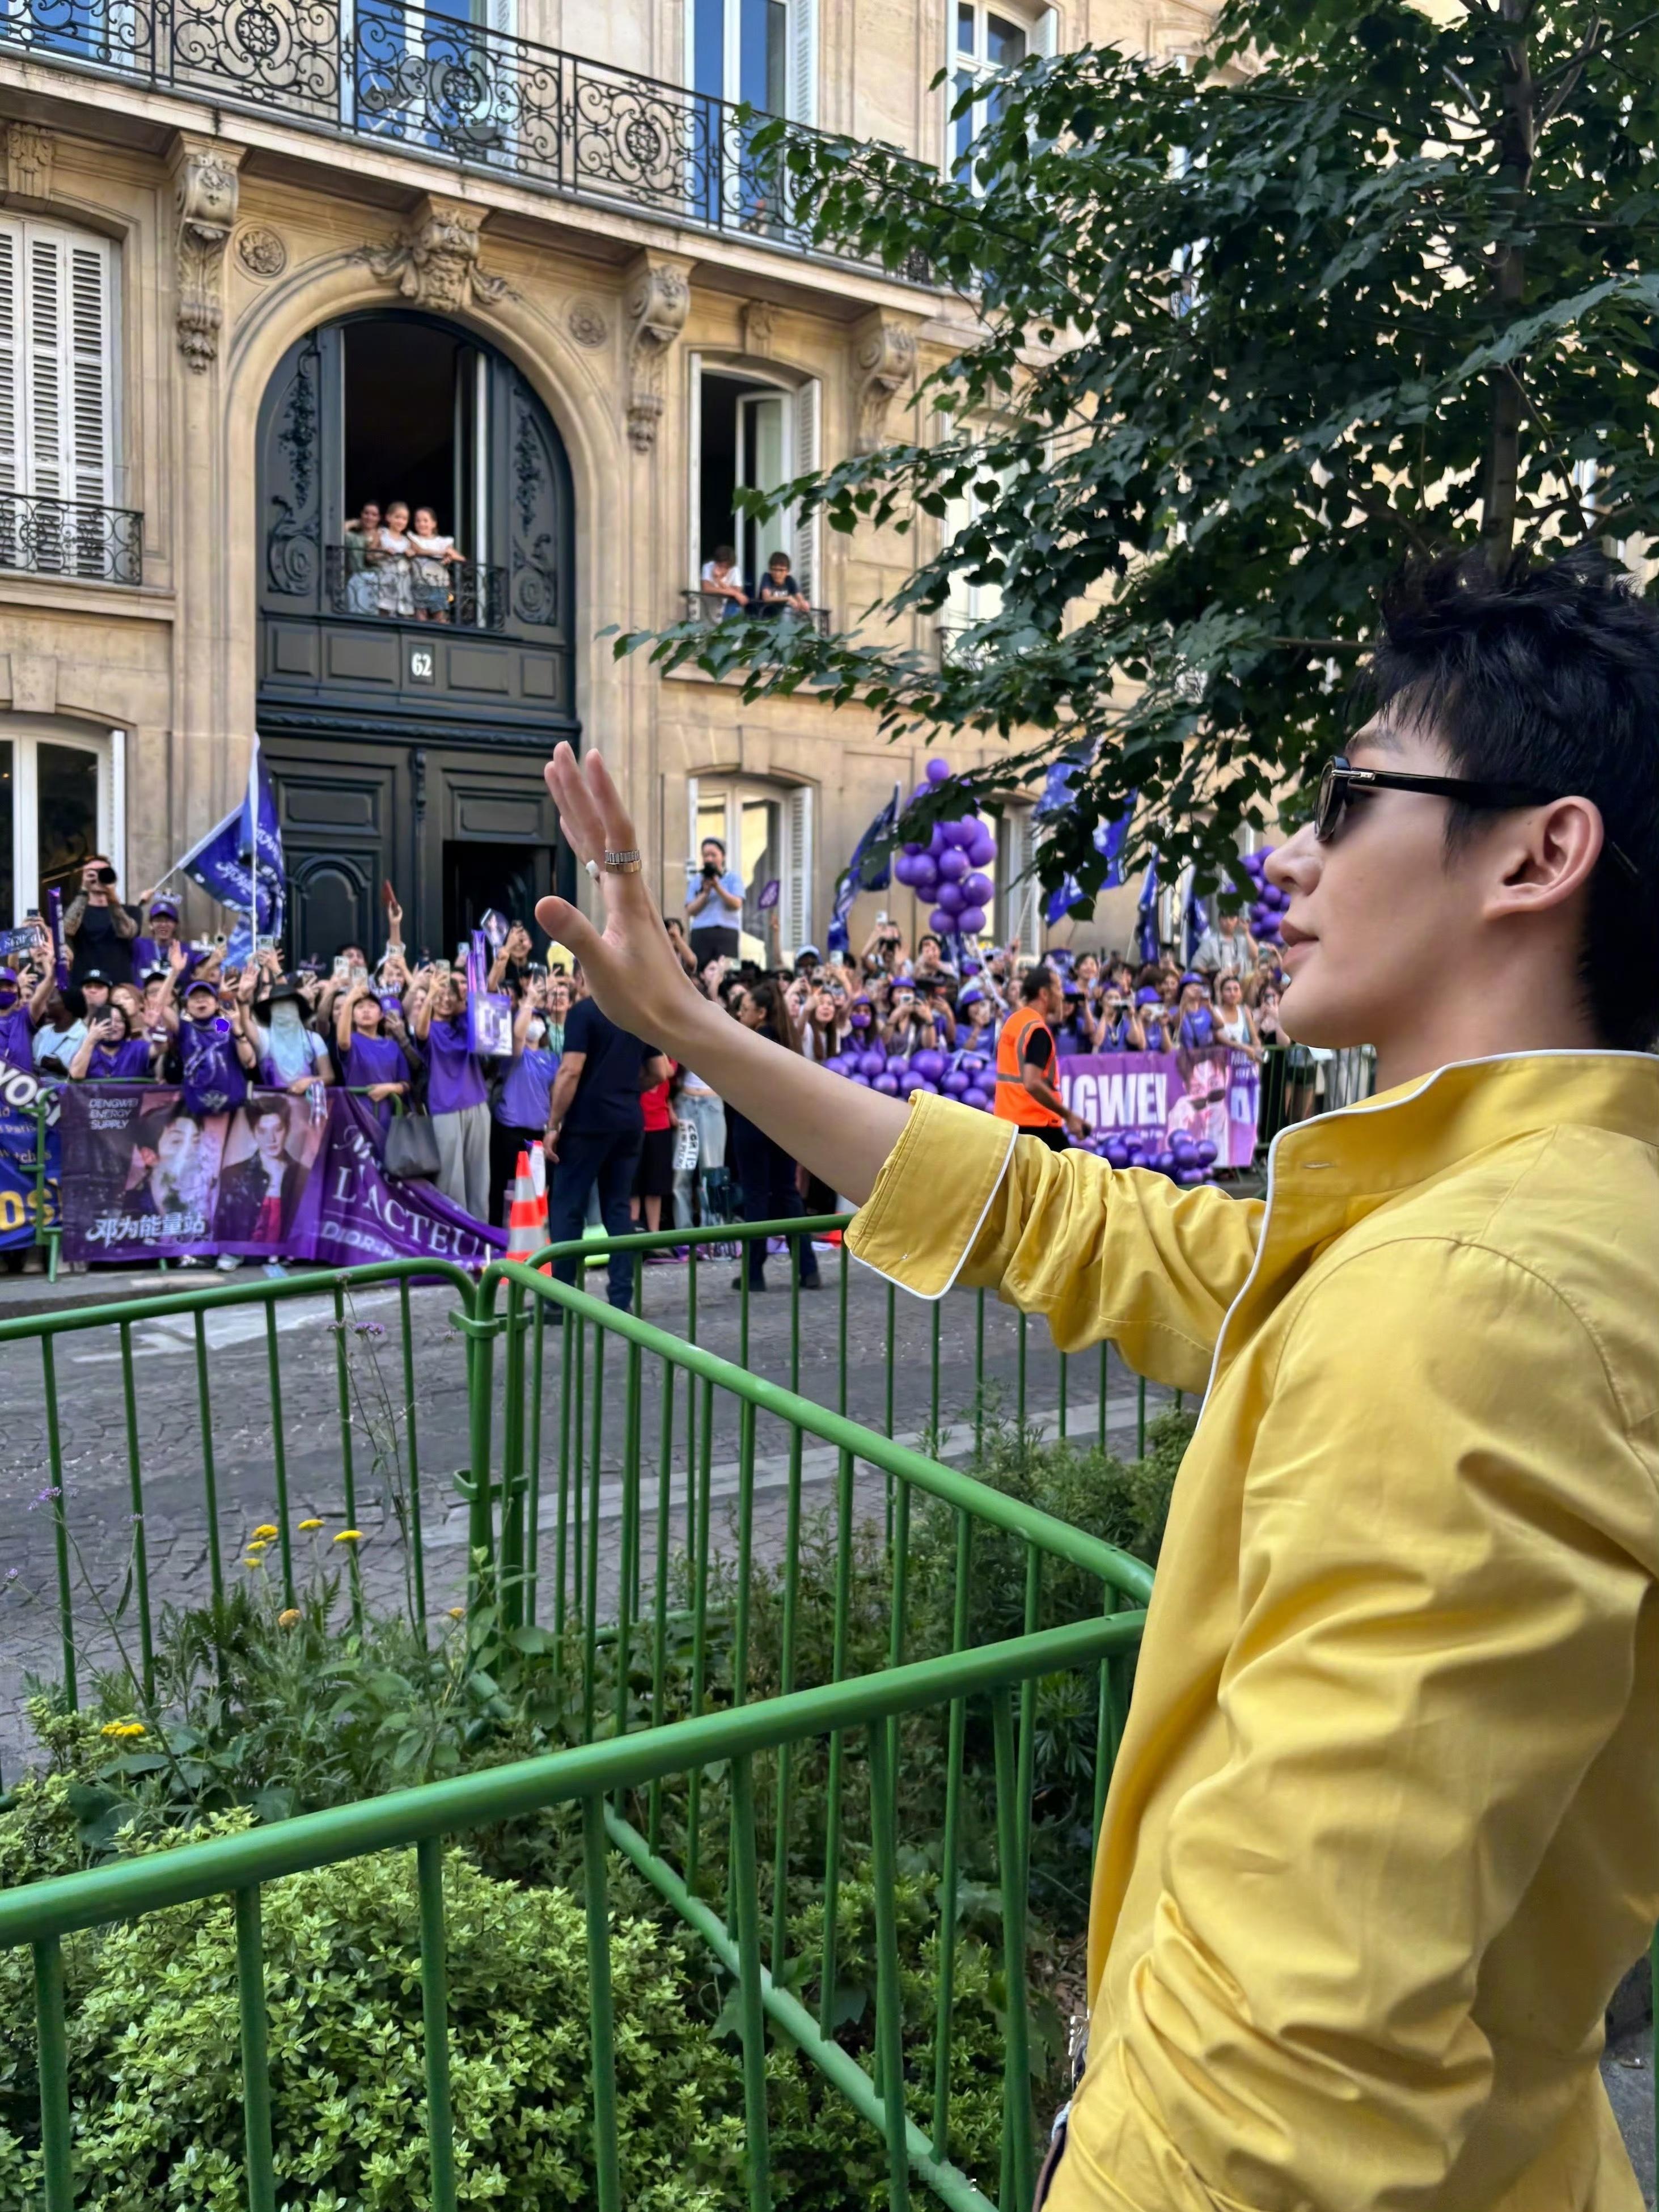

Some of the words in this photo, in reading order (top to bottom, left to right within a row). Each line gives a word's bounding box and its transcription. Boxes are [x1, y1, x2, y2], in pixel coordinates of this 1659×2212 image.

[412, 653, 432, 676] 62
[86, 1211, 206, 1250] 邓为能量站
